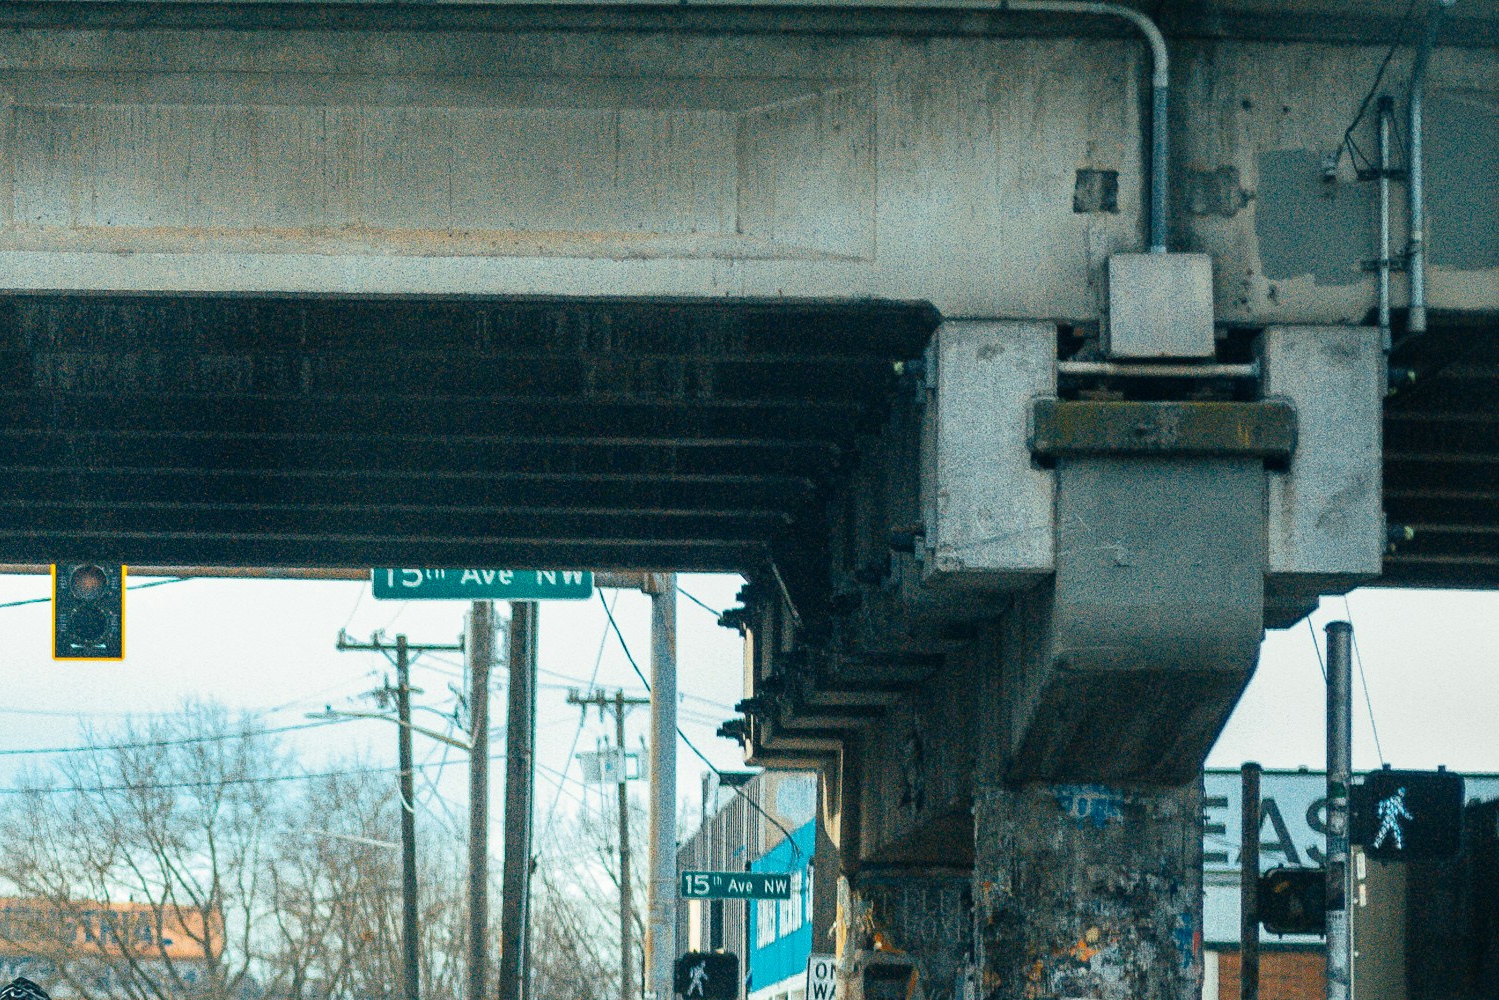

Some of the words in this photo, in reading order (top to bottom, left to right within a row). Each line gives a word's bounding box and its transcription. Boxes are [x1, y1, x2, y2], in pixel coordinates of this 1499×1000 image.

[461, 570, 514, 586] Ave
[536, 571, 583, 586] NW
[685, 874, 722, 895] 15th
[728, 879, 753, 893] Ave
[764, 879, 787, 894] NW
